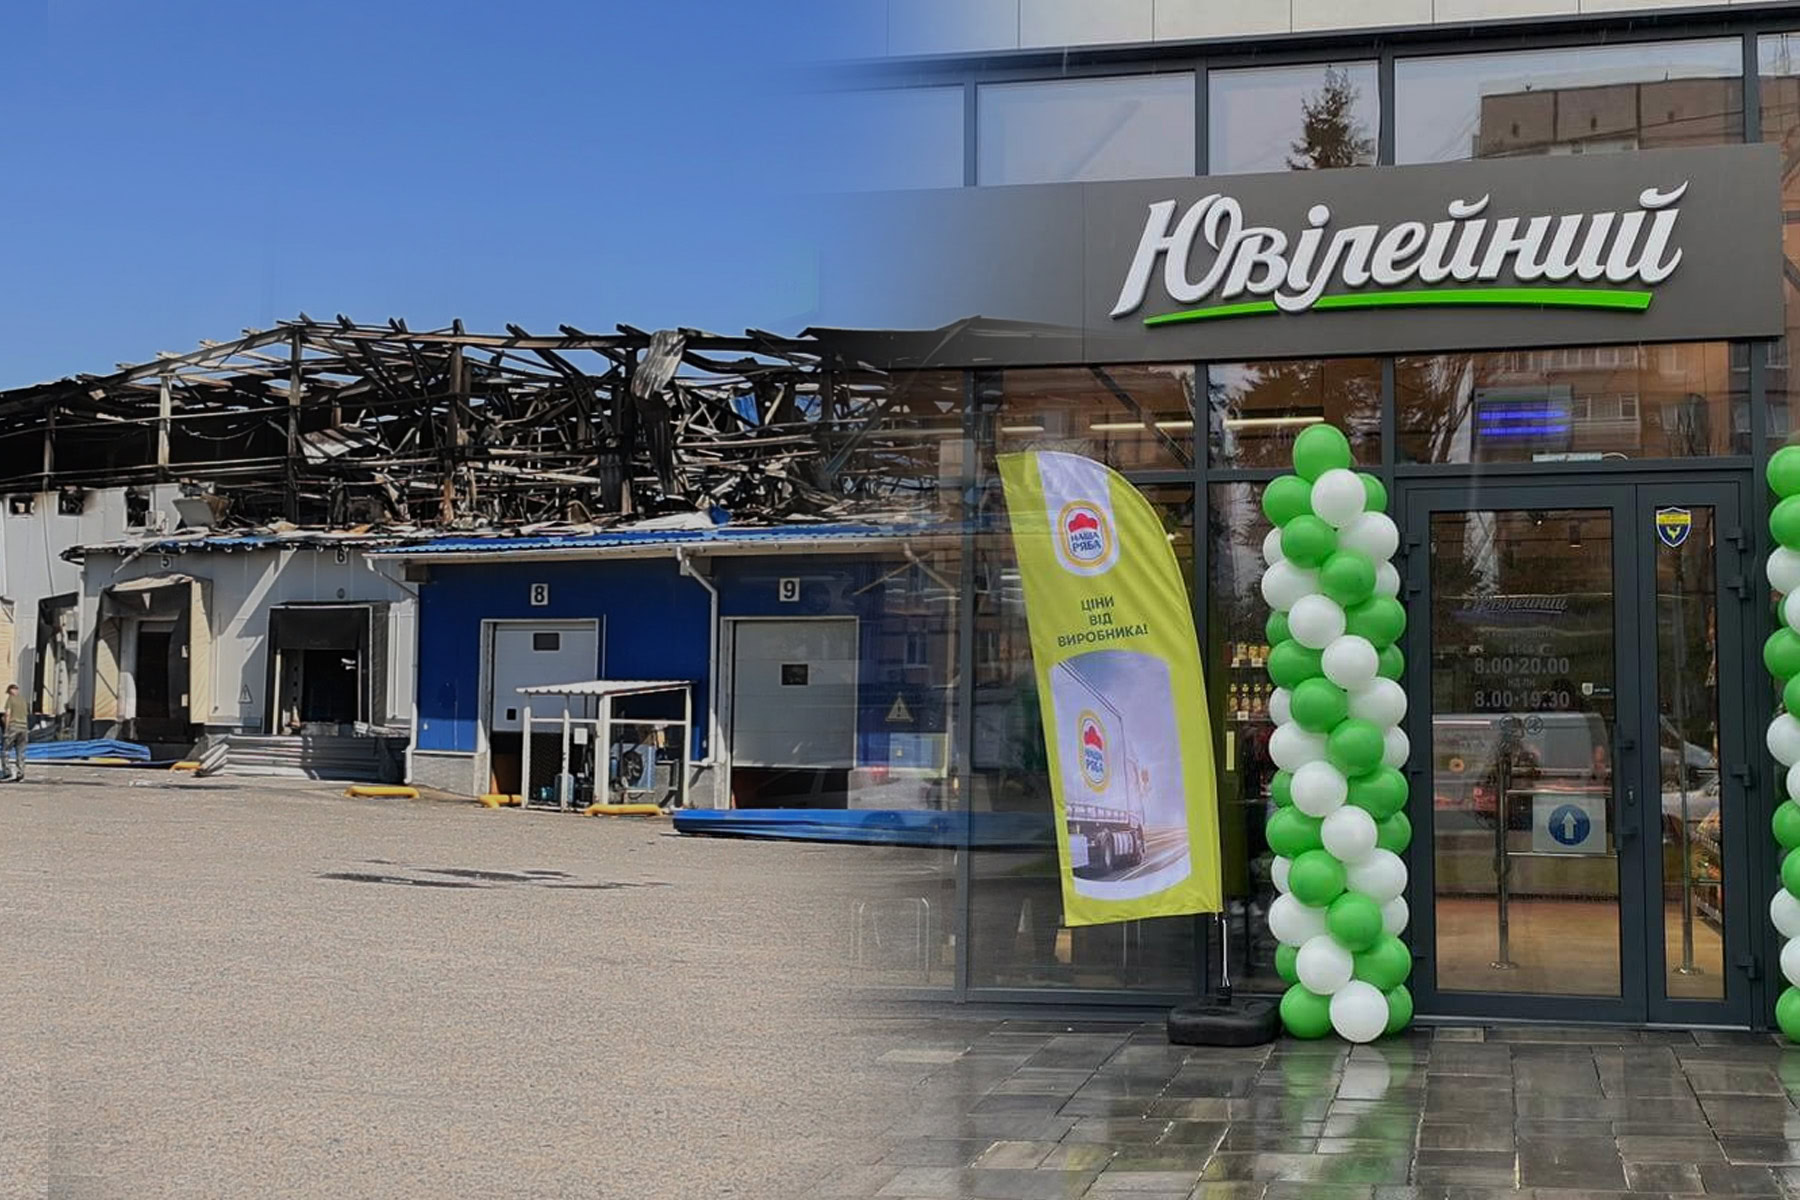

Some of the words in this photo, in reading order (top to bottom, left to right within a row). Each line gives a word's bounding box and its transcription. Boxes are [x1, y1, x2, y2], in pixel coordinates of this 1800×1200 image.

[1110, 181, 1689, 319] Ювілейний
[1070, 531, 1100, 542] НАША
[1072, 540, 1101, 552] РЯБА
[533, 585, 545, 603] 8
[783, 580, 796, 599] 9
[1081, 596, 1115, 611] ЦІНИ
[1089, 614, 1113, 626] ВІД
[1058, 624, 1148, 647] ВИРОБНИКА!
